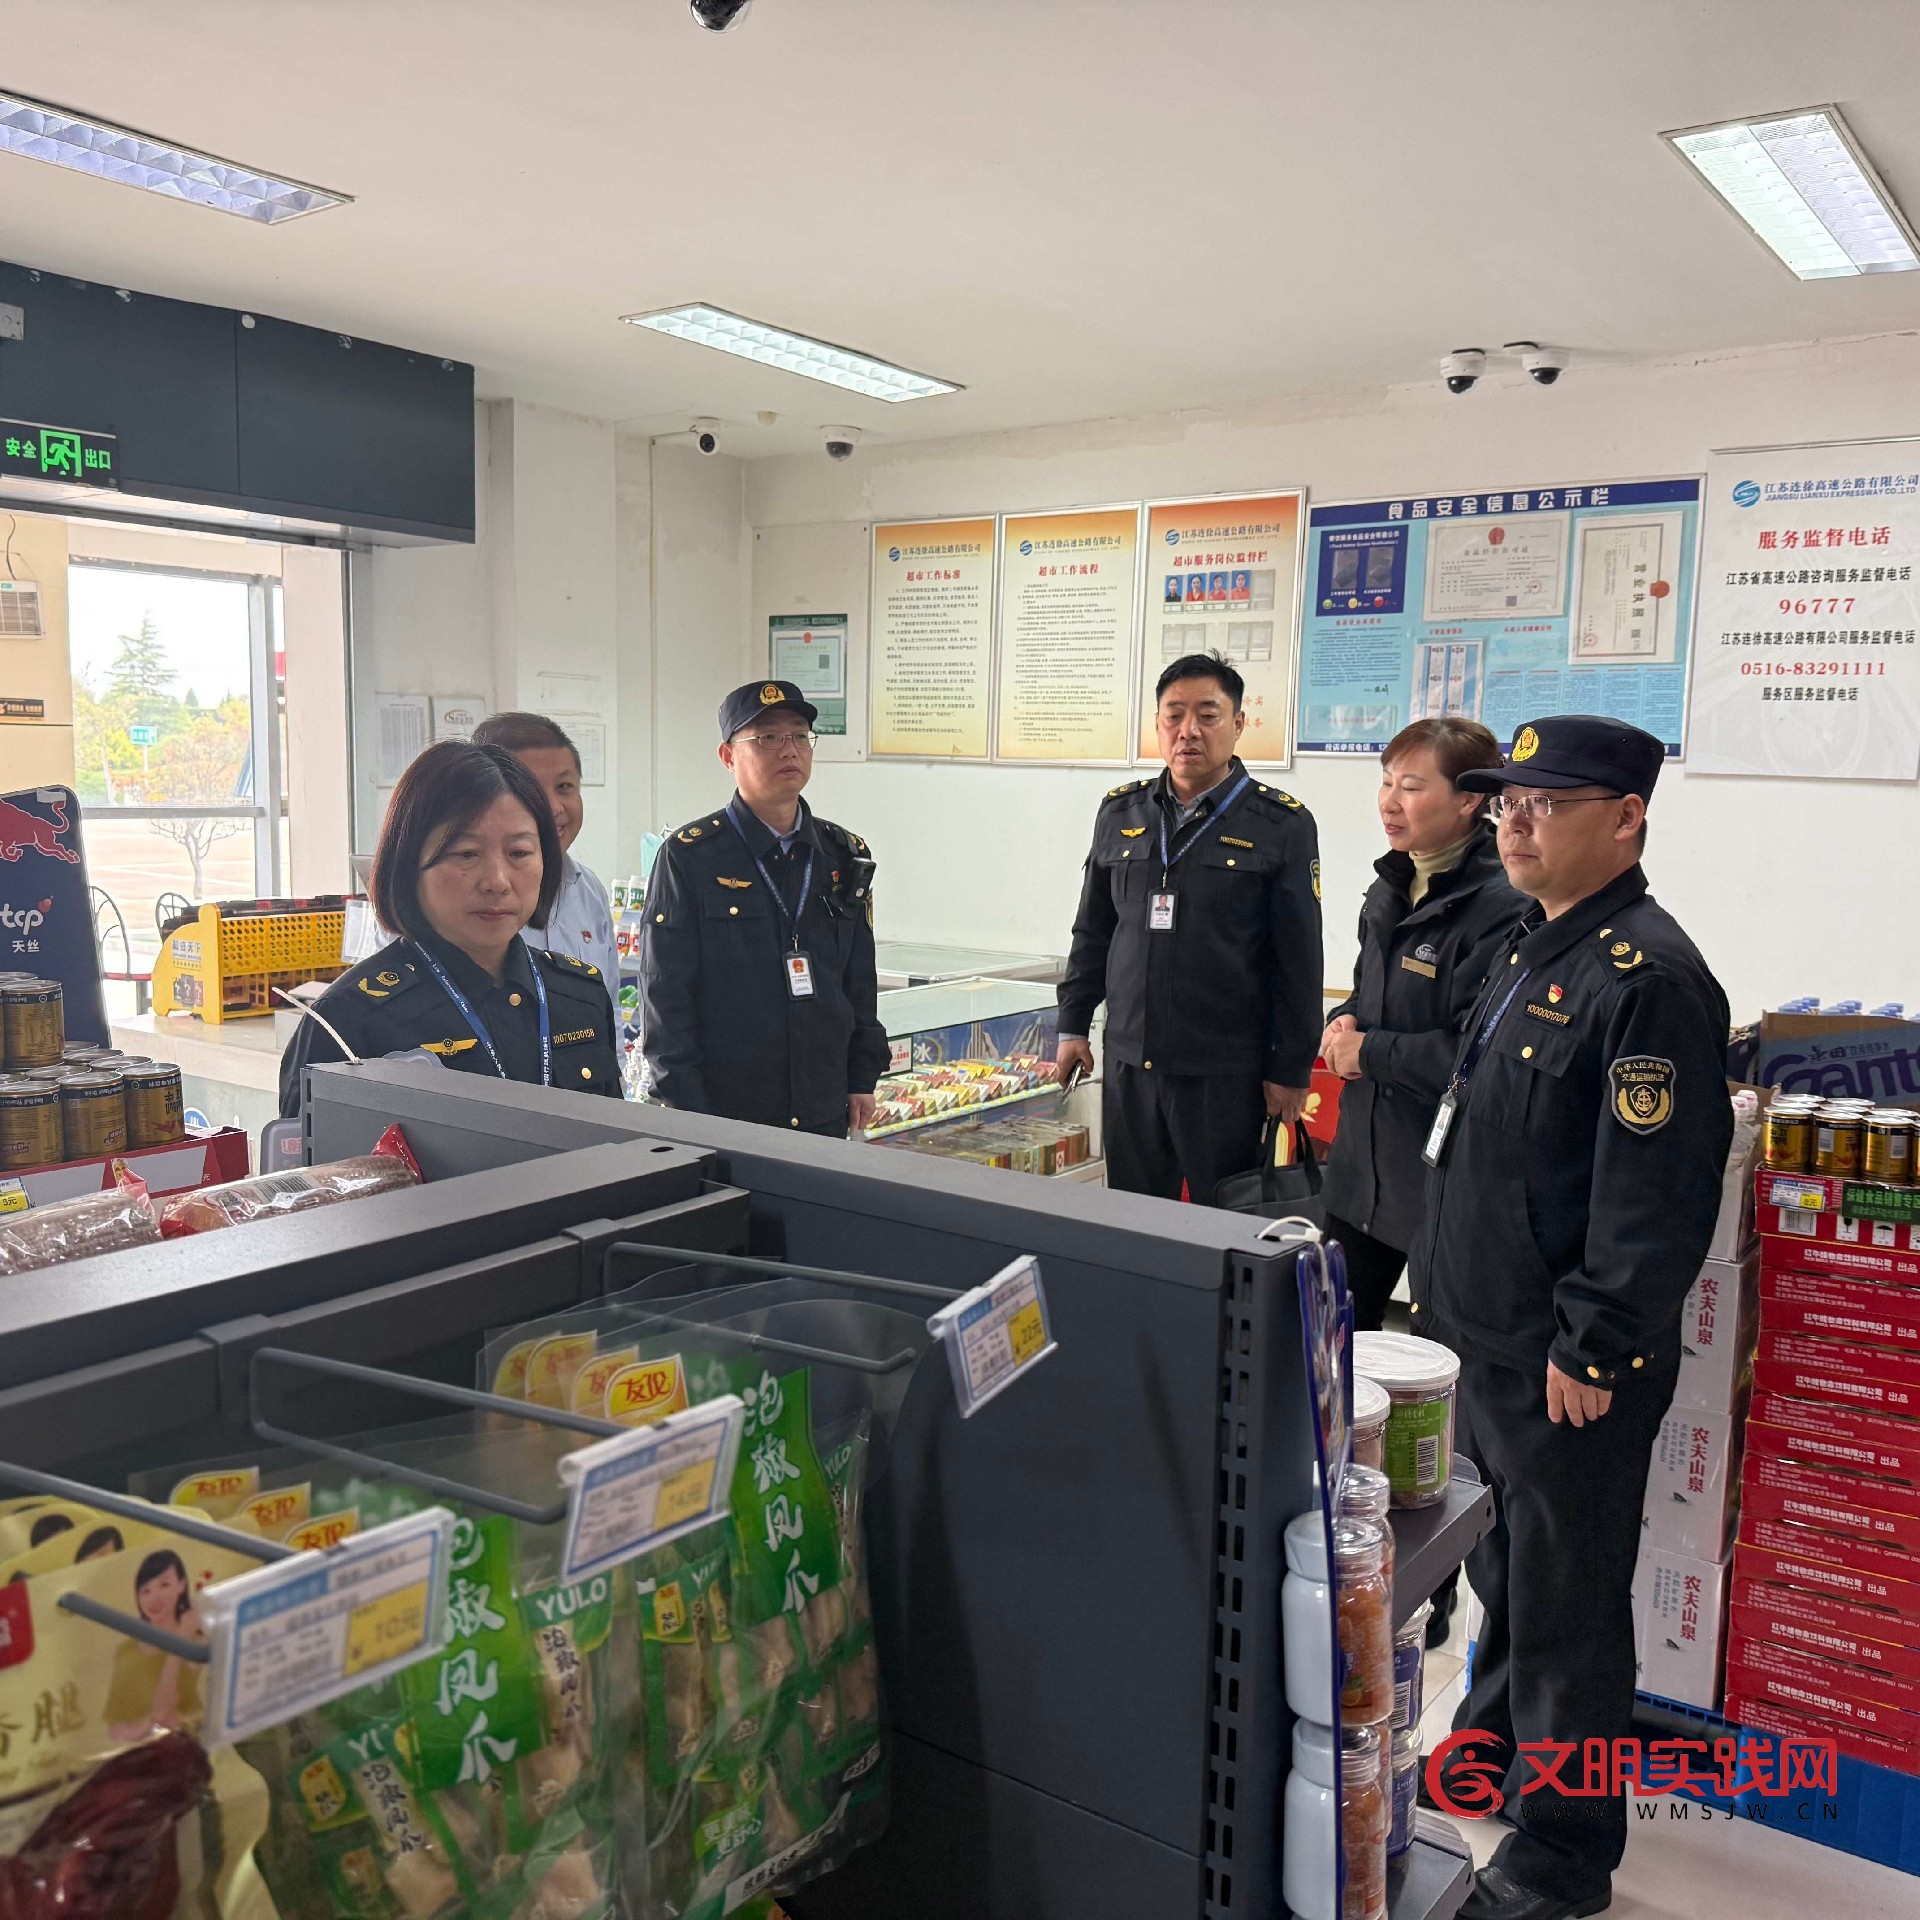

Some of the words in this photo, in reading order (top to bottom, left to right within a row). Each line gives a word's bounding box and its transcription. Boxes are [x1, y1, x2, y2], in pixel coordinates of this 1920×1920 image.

[6, 437, 37, 459] 安全
[84, 448, 111, 470] 出口
[1765, 474, 1919, 494] 江苏连徐高速公路有限公司
[1831, 488, 1883, 498] EXPRESSWAY
[1388, 487, 1609, 521] 食品安全信息公示栏
[1758, 526, 1892, 550] 服务监督电话
[1173, 550, 1268, 567] 超市服务岗位监督栏
[906, 569, 961, 582] 超市工作标准
[1038, 564, 1099, 577] 超市工作流程
[1726, 566, 1912, 586] 江苏省高速公路咨询服务监督电话
[1779, 598, 1856, 614] 96777
[1720, 630, 1916, 646] 江苏连徐高速公路有限公司服务监督电话
[1741, 662, 1886, 676] 0516-83291111
[1762, 687, 1858, 701] 服务区服务监督电话
[0, 903, 43, 936] tcp
[12, 940, 40, 954] 天丝
[1616, 1062, 1671, 1074] 中华人民共和国
[1898, 1262, 1918, 1274] 出品
[1696, 1278, 1719, 1346] 农夫山泉
[1897, 1327, 1918, 1338] 出品
[1888, 1392, 1908, 1404] 出品
[1688, 1427, 1710, 1494] 农夫山泉
[1880, 1456, 1900, 1468] 出品
[743, 1369, 819, 1614] 泡椒凤爪
[1875, 1520, 1895, 1532] 出品
[1867, 1583, 1887, 1596] 出品
[536, 1577, 607, 1621] YULO
[1680, 1575, 1702, 1642] 农夫山泉
[1862, 1647, 1882, 1659] 出品
[1857, 1708, 1876, 1721] 出品
